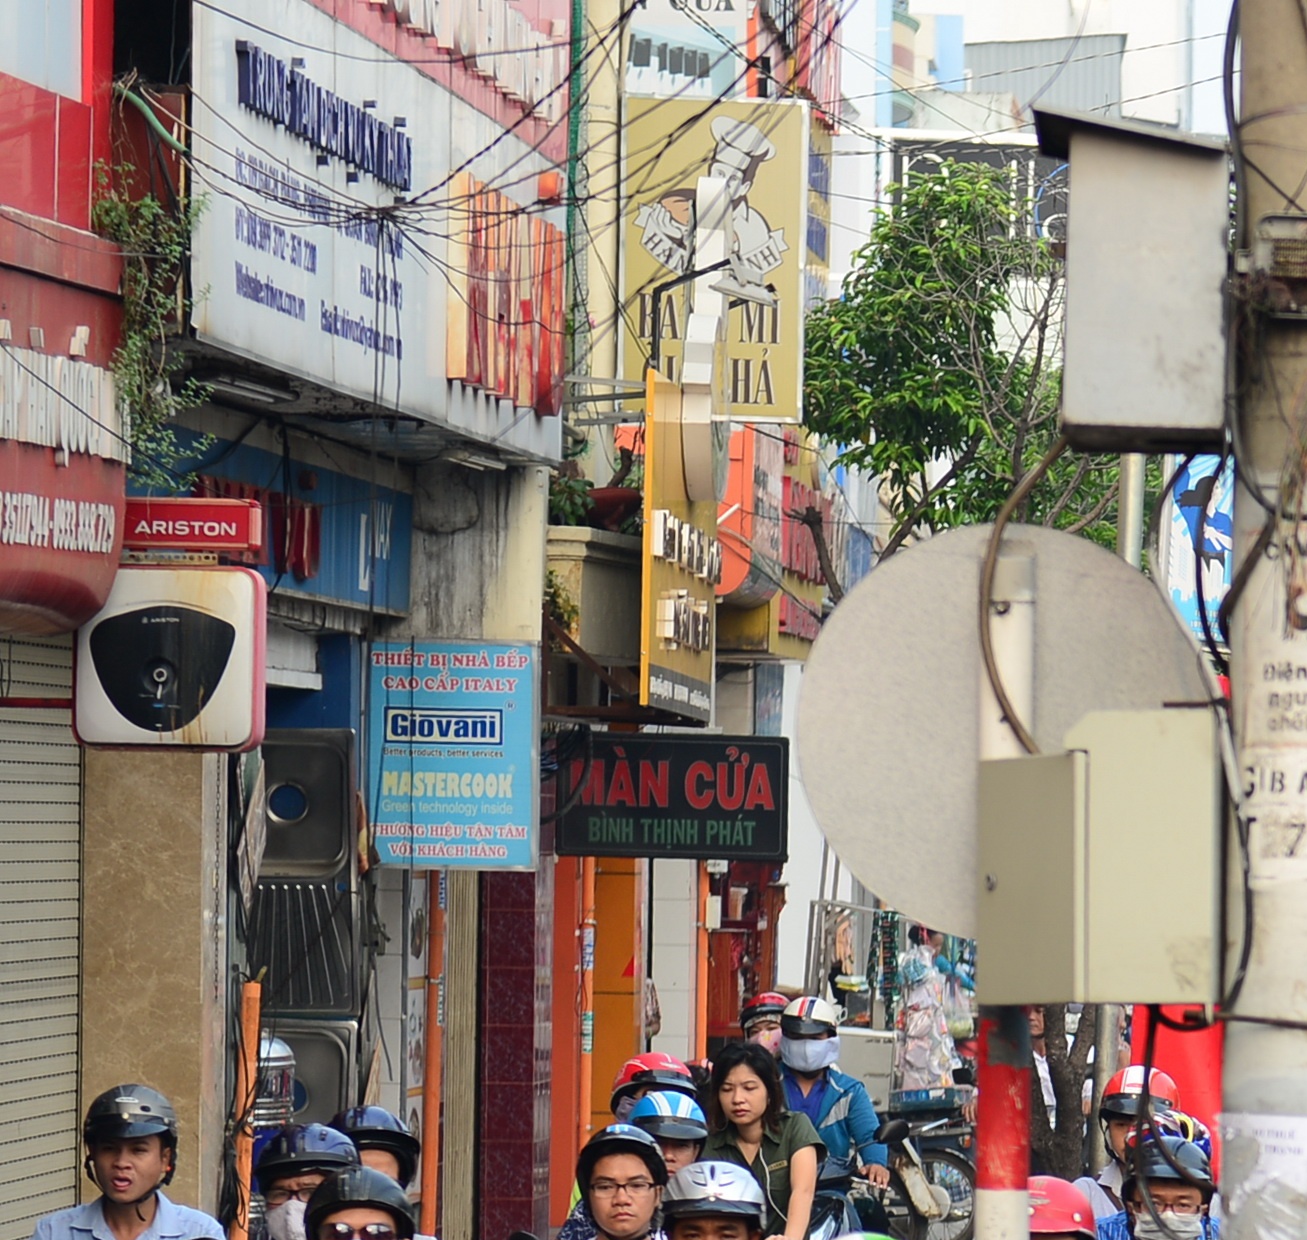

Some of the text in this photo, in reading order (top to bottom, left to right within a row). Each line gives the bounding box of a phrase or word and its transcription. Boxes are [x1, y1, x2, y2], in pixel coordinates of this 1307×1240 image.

[236, 40, 291, 127] TRUNG
[135, 520, 236, 537] ARISTON
[373, 647, 528, 670] THIẾT BỊ NHÀ BẾP
[383, 671, 517, 693] CAO CẤP ITALY
[391, 713, 496, 738] Giovani
[383, 747, 406, 757] Better
[447, 748, 470, 758] better
[471, 749, 504, 758] services
[382, 771, 513, 799] MASTERCOOK
[570, 746, 776, 811] MÀN CỬA
[382, 800, 513, 817] Green technology inside
[429, 821, 463, 840] HIỆU
[466, 822, 493, 841] TẬN
[497, 823, 527, 838] TÂM
[588, 810, 757, 849] BÌNH THỊNH PHÁT
[417, 842, 466, 857] KHÁCH
[469, 843, 507, 857] HÀNG
